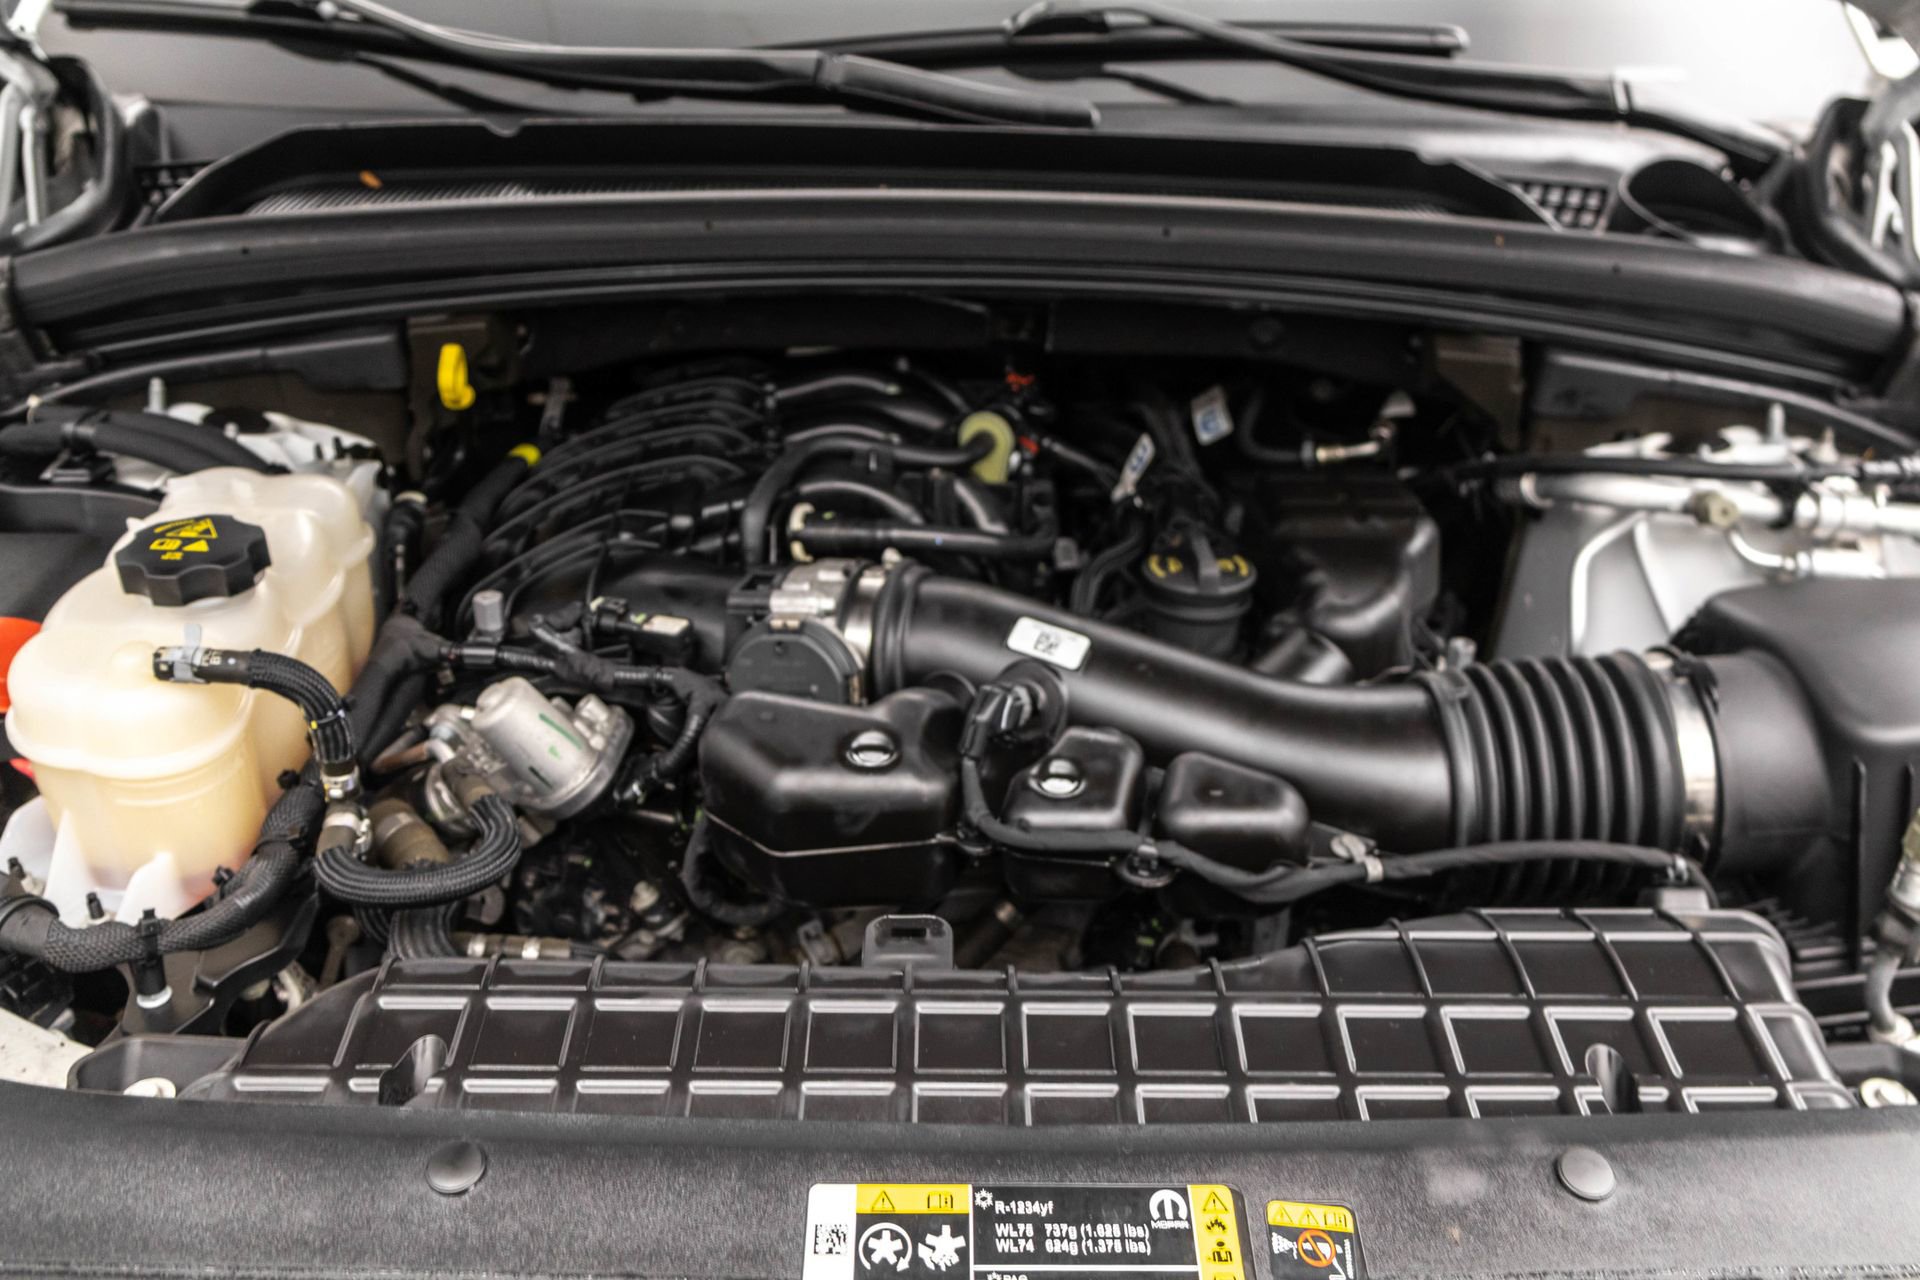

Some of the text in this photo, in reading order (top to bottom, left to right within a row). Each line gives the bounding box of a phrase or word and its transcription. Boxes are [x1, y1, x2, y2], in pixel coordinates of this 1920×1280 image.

[995, 1200, 1053, 1217] R-1234yf
[1044, 1223, 1077, 1240] 737g
[995, 1239, 1035, 1253] WL74
